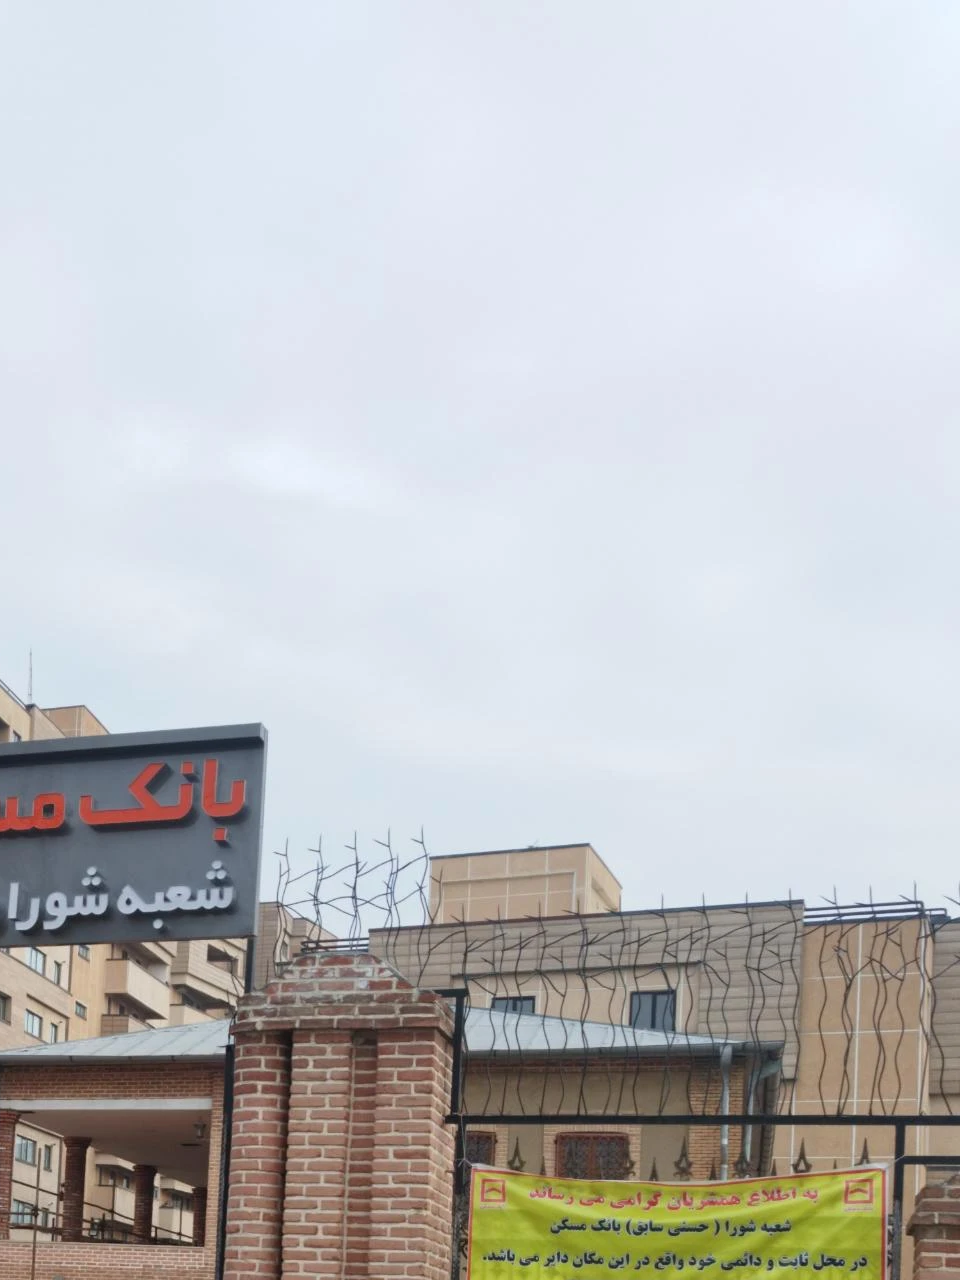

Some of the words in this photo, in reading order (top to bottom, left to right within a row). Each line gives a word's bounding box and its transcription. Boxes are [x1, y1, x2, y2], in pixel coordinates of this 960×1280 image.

[80, 758, 246, 842] بانک
[7, 866, 109, 931] شورا
[117, 860, 234, 930] شعبه
[529, 1186, 574, 1205] رساند
[579, 1195, 605, 1206] می
[610, 1191, 662, 1211] گرامی
[747, 1187, 796, 1206] اطلاع
[803, 1187, 818, 1203] به
[550, 1218, 587, 1234] مسکن
[590, 1219, 621, 1233] بانک
[725, 1219, 756, 1237] شورا
[761, 1219, 792, 1236] شعبه
[519, 1255, 540, 1267] می
[572, 1251, 604, 1268] مکان
[608, 1252, 630, 1269] این
[634, 1256, 650, 1270] در
[654, 1251, 684, 1271] واقع
[689, 1252, 716, 1271] خود
[778, 1251, 809, 1268] ثابت
[813, 1253, 846, 1271] محل
[850, 1256, 868, 1272] در
